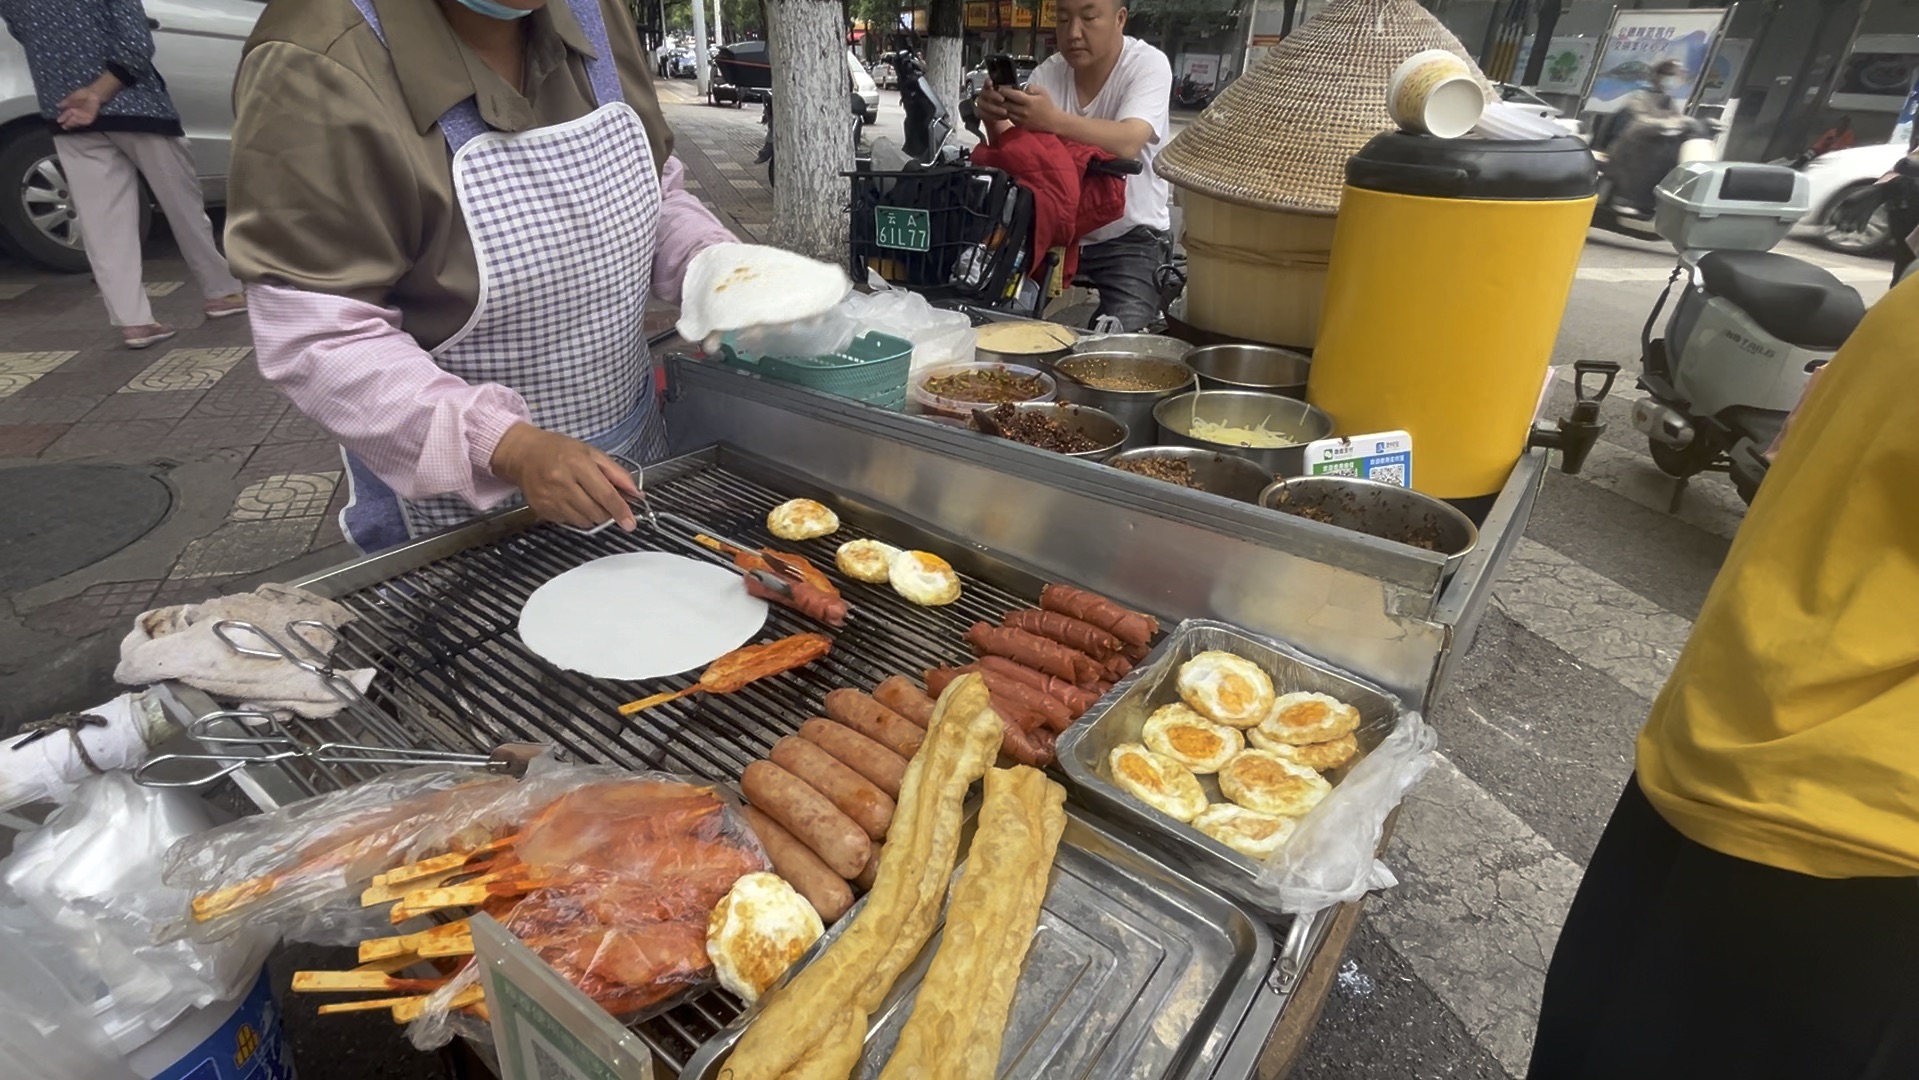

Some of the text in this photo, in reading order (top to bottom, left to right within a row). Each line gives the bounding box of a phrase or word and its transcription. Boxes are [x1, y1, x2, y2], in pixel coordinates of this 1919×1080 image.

[887, 212, 917, 227] 云 A
[879, 226, 927, 248] 61L77
